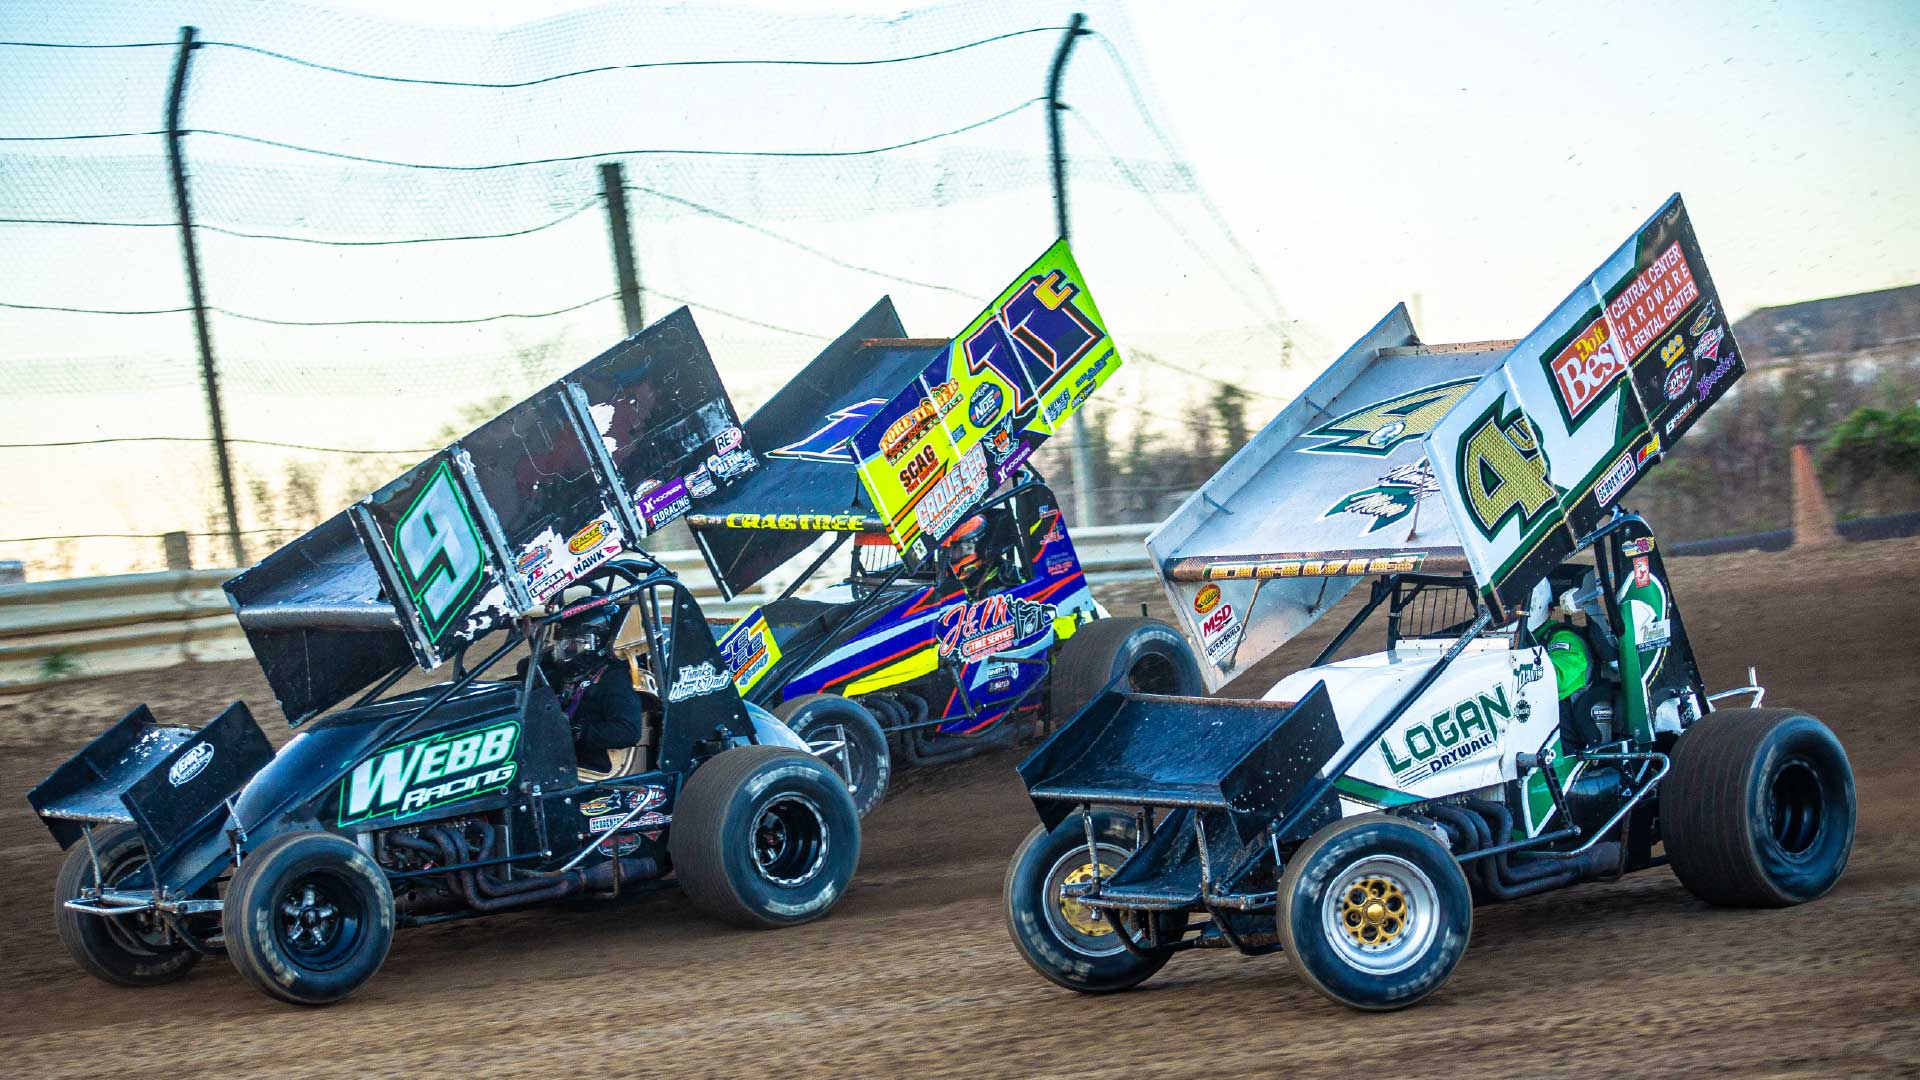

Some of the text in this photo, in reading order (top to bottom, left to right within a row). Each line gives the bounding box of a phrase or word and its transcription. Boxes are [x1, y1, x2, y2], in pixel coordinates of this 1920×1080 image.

[1613, 245, 1681, 319] CENTRAL CENTER
[1618, 264, 1689, 336] HARDWARE
[1626, 343, 1635, 357] &
[1634, 317, 1665, 350] RENTAL
[1665, 283, 1697, 321] CENTER
[1557, 343, 1627, 408] Best
[975, 390, 995, 419] NOS
[899, 444, 936, 487] SCAG
[653, 495, 690, 523] FLORACING
[726, 513, 866, 531] CRABTREE
[398, 468, 482, 624] 9
[574, 527, 600, 546] RACER
[527, 566, 544, 586] JE
[574, 550, 604, 574] HAWK
[530, 568, 566, 598] LINCOLN
[987, 626, 1014, 645] SERVICE
[1203, 605, 1231, 637] MSD
[670, 682, 694, 701] Mom
[706, 673, 728, 690] Dad
[680, 663, 715, 683] Thanks
[1517, 667, 1543, 692] DAVIS
[1380, 685, 1512, 774] LOGAN
[1430, 735, 1492, 773] DRYWALL
[349, 725, 515, 816] WEBB
[401, 764, 515, 811] RACING
